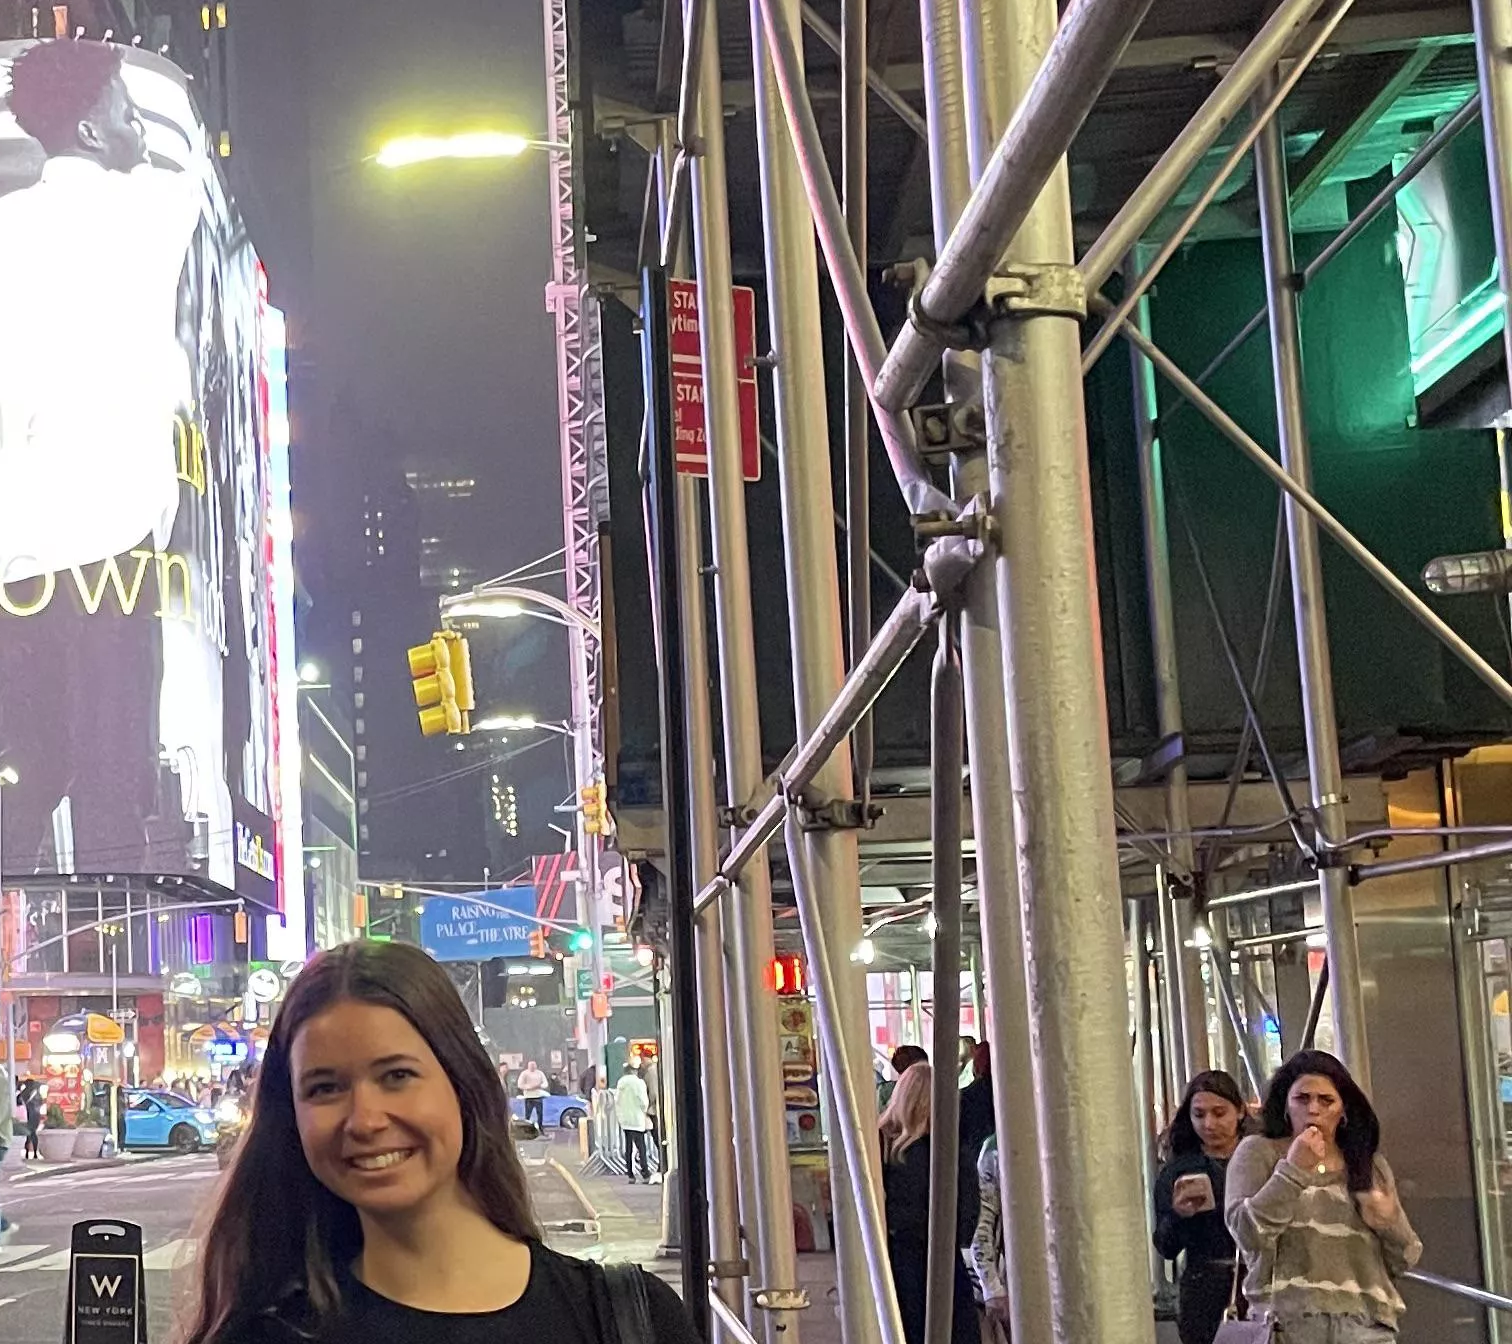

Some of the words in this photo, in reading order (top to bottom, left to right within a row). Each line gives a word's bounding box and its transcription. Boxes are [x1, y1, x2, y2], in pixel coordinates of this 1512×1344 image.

[673, 291, 696, 309] STA
[436, 922, 478, 938] PALACE
[476, 925, 529, 944] THEATRE
[90, 1275, 122, 1298] W
